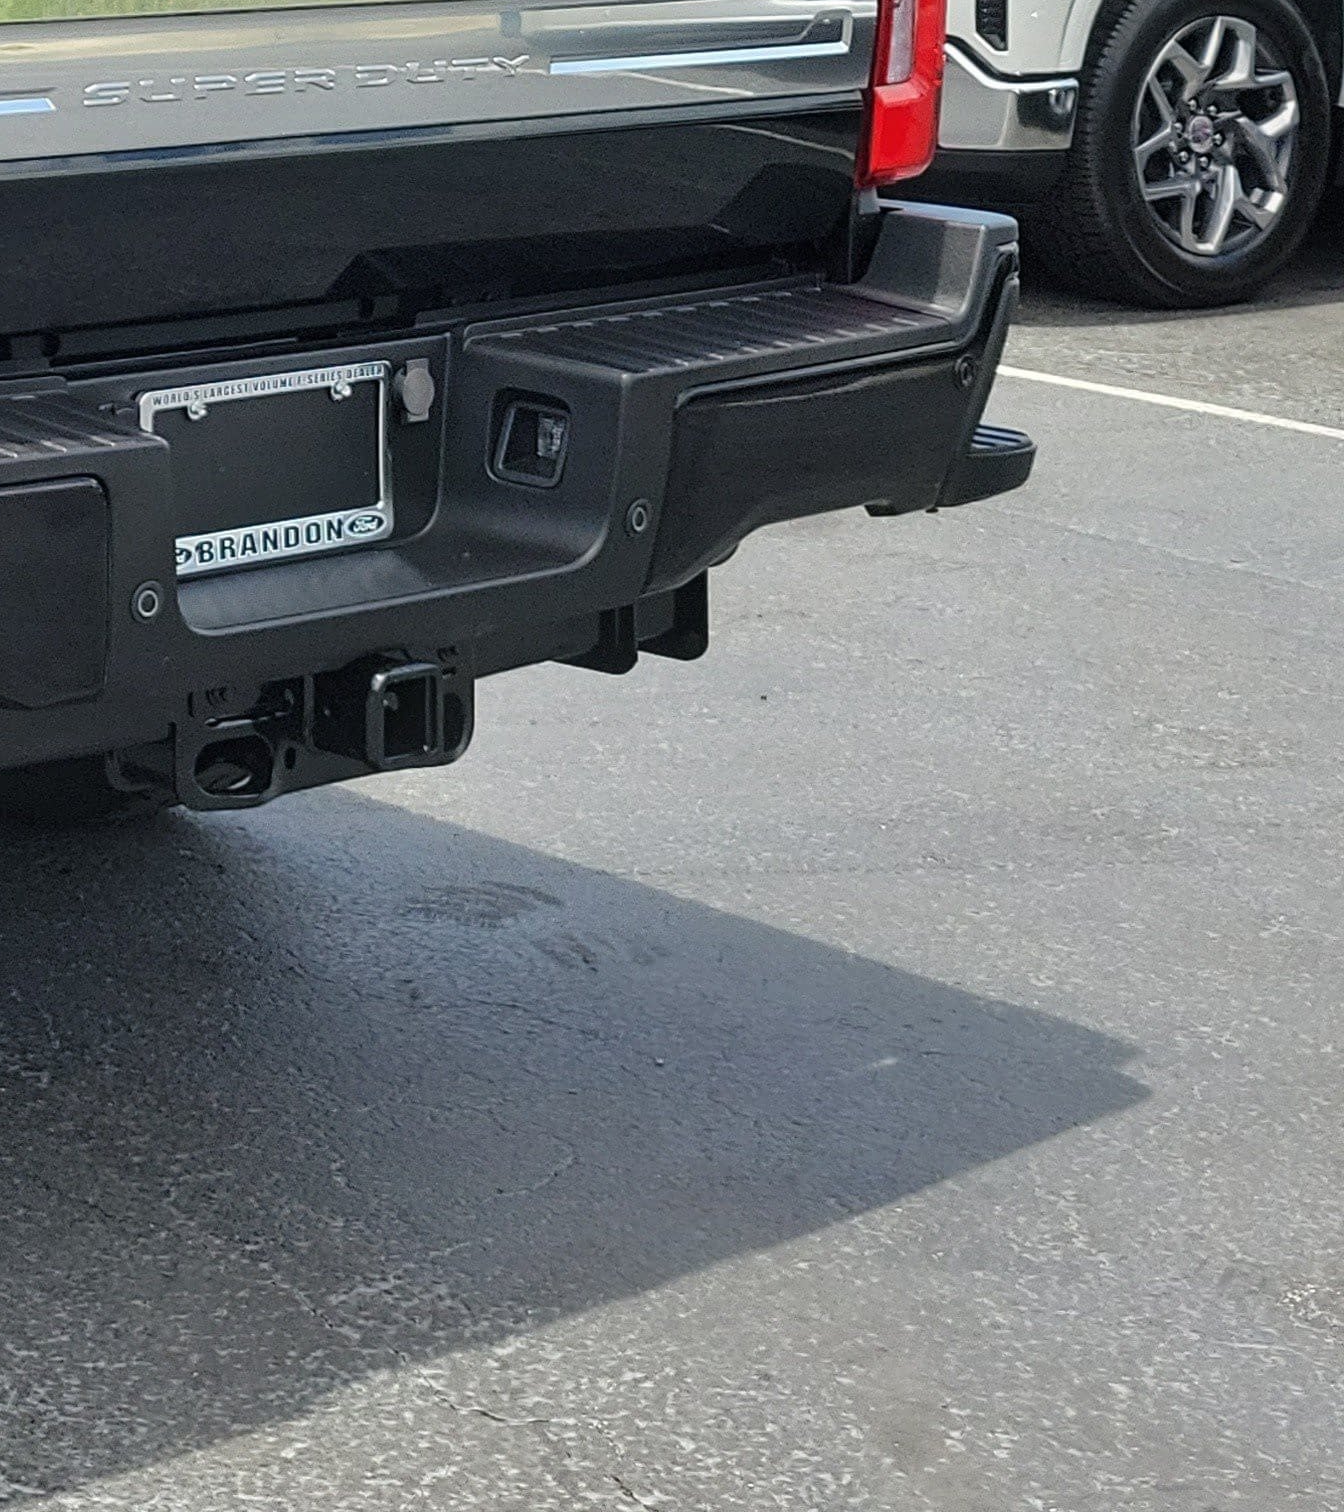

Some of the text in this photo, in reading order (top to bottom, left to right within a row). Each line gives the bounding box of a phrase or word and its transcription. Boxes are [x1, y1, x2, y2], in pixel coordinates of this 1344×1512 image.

[83, 55, 530, 107] SUPER DUTY
[203, 383, 249, 399] LARGEST
[252, 376, 293, 392] VOLUME
[195, 517, 345, 564] BRANDON
